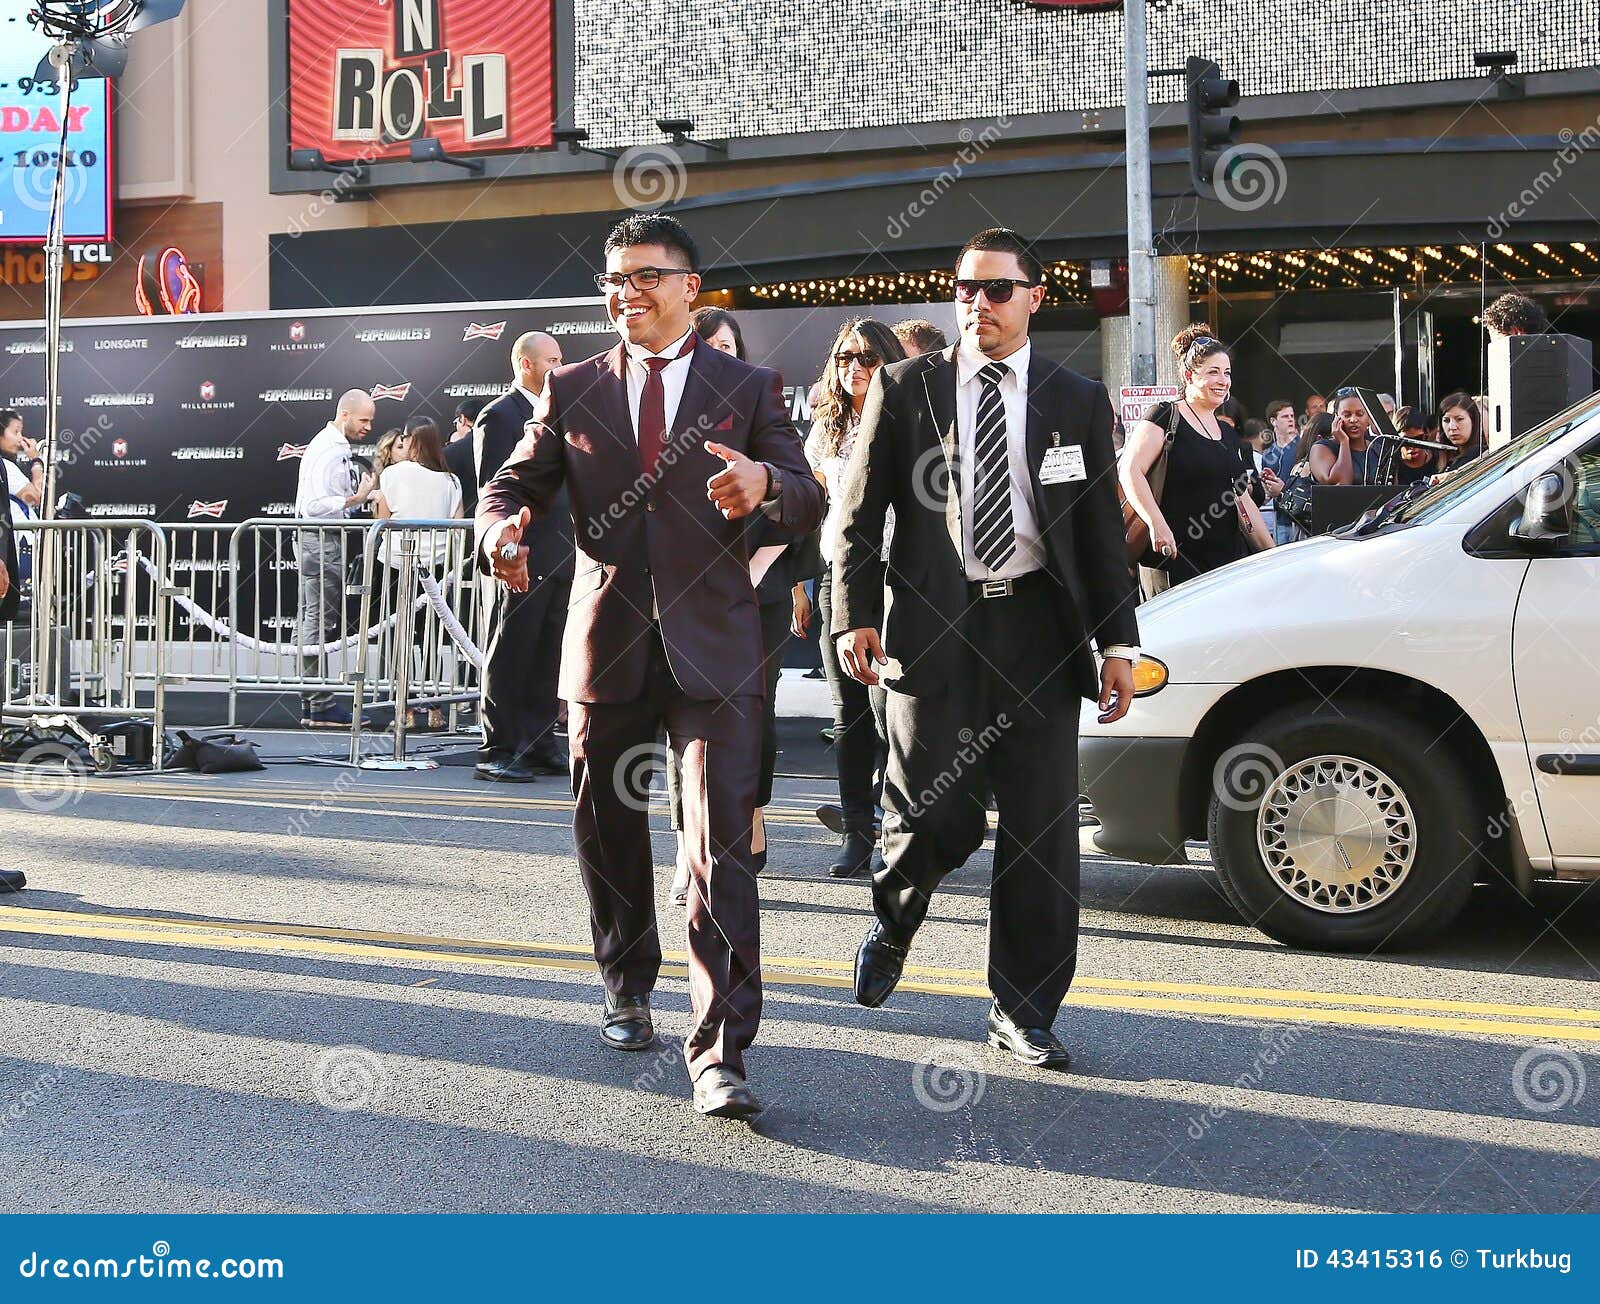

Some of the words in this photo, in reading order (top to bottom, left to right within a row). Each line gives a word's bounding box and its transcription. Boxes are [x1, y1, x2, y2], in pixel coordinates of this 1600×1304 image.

[337, 52, 504, 140] ROLL
[69, 244, 112, 263] TCL
[94, 338, 149, 350] LIONSGATE
[270, 342, 326, 351] MILLENNIUM
[1127, 388, 1171, 397] TOW-AWAY
[181, 402, 235, 410] MILLENNIUM
[1124, 404, 1141, 420] NO
[94, 459, 147, 467] MILLENNIUM
